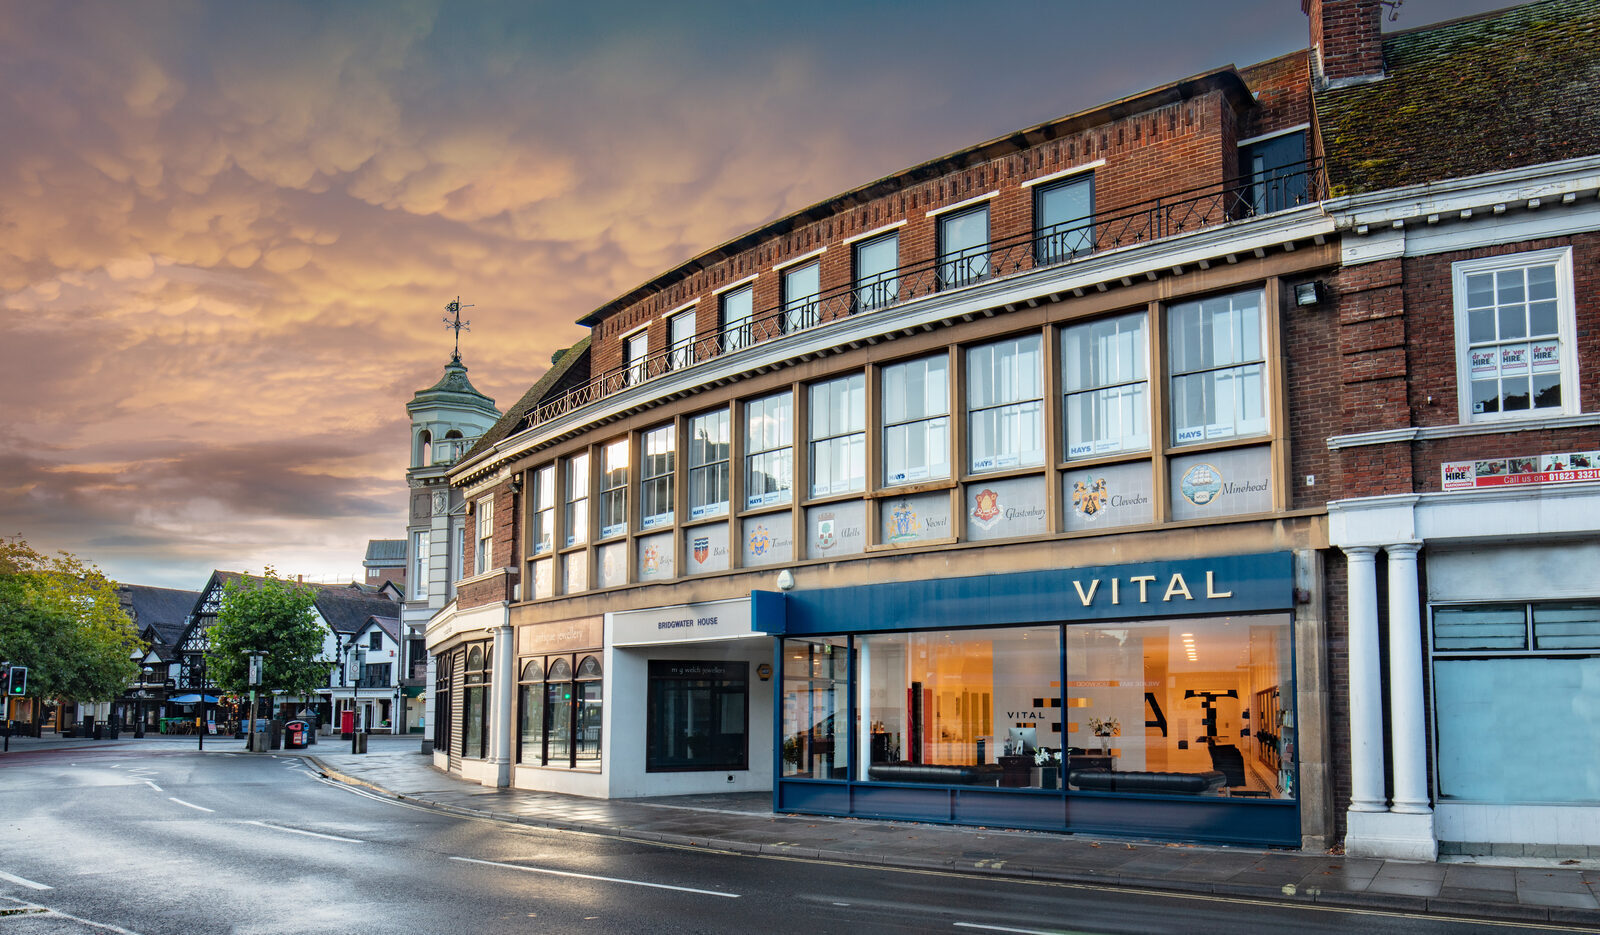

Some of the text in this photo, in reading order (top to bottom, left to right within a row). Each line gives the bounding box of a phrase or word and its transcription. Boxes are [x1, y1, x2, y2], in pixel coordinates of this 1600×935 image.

[1534, 351, 1551, 359] HIRE
[1473, 358, 1489, 366] HIRE
[1179, 430, 1202, 440] HAYS
[1071, 446, 1091, 454] HAYS
[975, 460, 992, 468] HAYS
[1446, 472, 1465, 481] HIRE
[1504, 475, 1519, 484] Call
[1222, 478, 1268, 496] Minehead
[1111, 493, 1148, 507] Clevedon
[1005, 505, 1046, 521] Glastonbury
[1072, 570, 1233, 606] VITAL
[658, 616, 718, 630] BRIDGWATER HOUSE
[1007, 711, 1045, 719] VITAL
